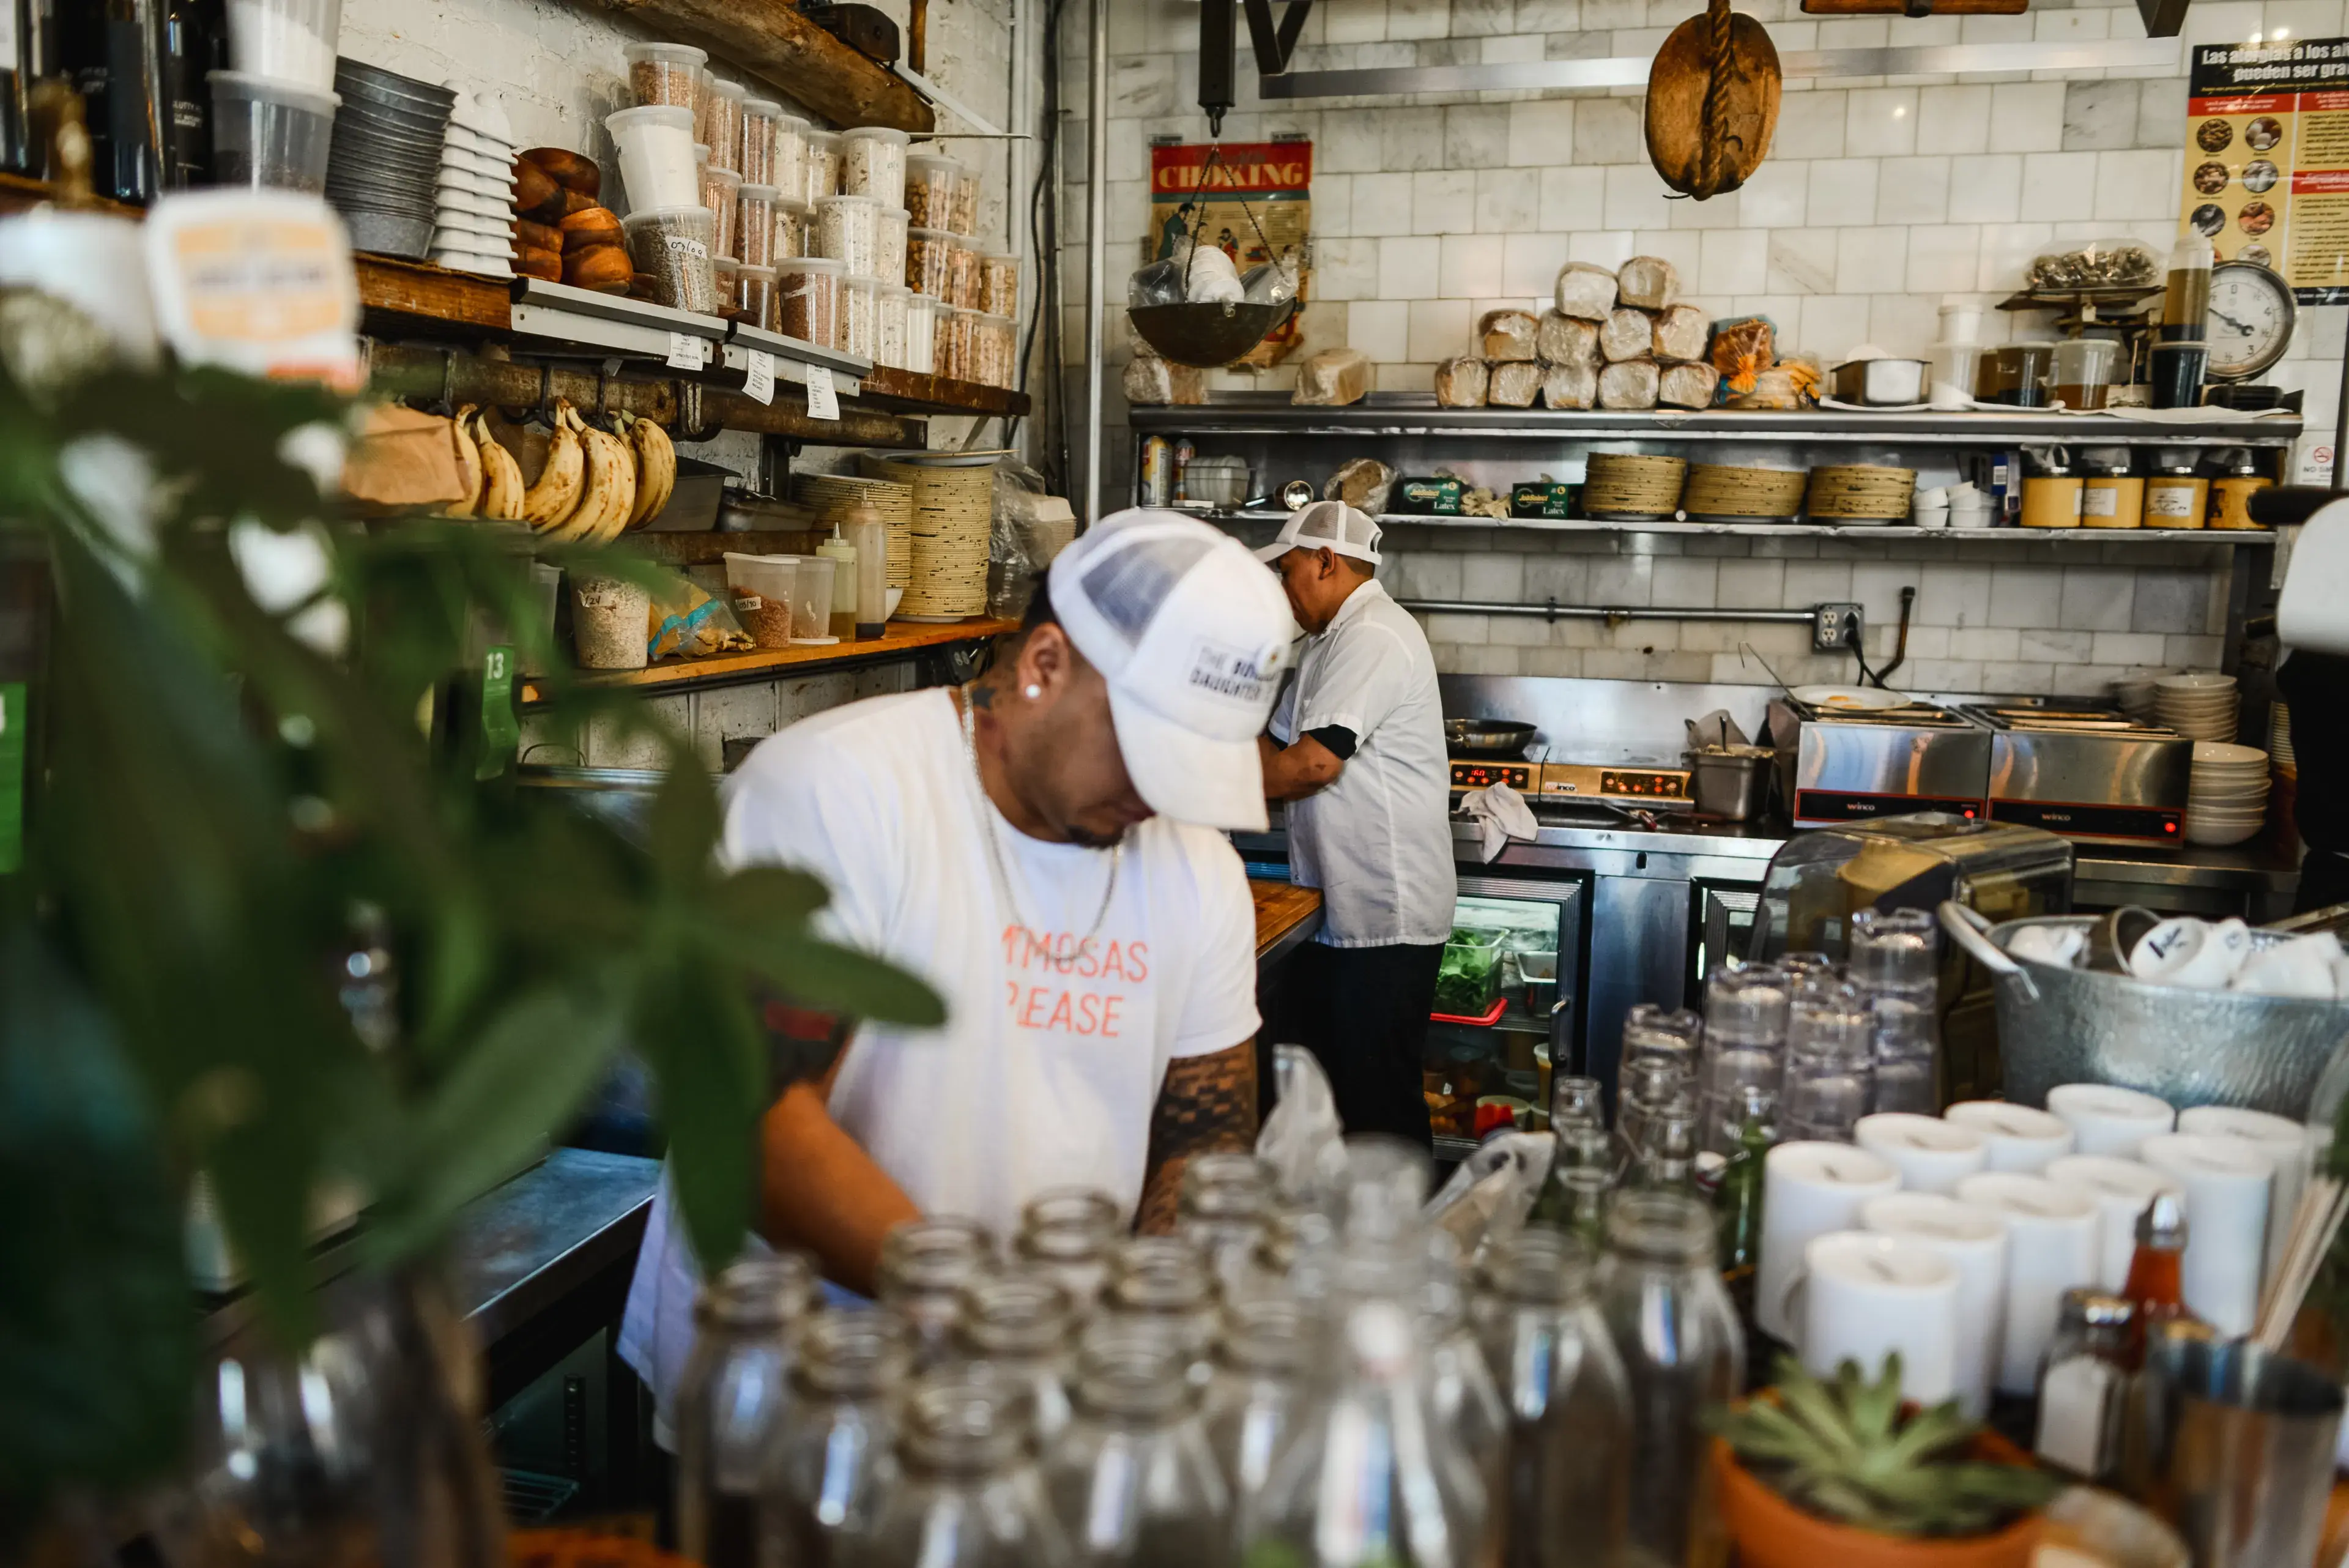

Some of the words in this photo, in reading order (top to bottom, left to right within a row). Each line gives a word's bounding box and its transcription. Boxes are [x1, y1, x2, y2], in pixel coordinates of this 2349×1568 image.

[2202, 49, 2227, 65] Las
[2294, 48, 2303, 60] a
[2306, 44, 2329, 59] los
[2233, 65, 2291, 83] pueden
[2293, 64, 2318, 78] ser
[1158, 163, 1304, 188] CHOKING
[1433, 501, 1455, 510] Latex
[1543, 506, 1565, 515] Latex
[486, 652, 504, 680] 13
[1847, 802, 1876, 811] winco
[2041, 812, 2071, 821] winco
